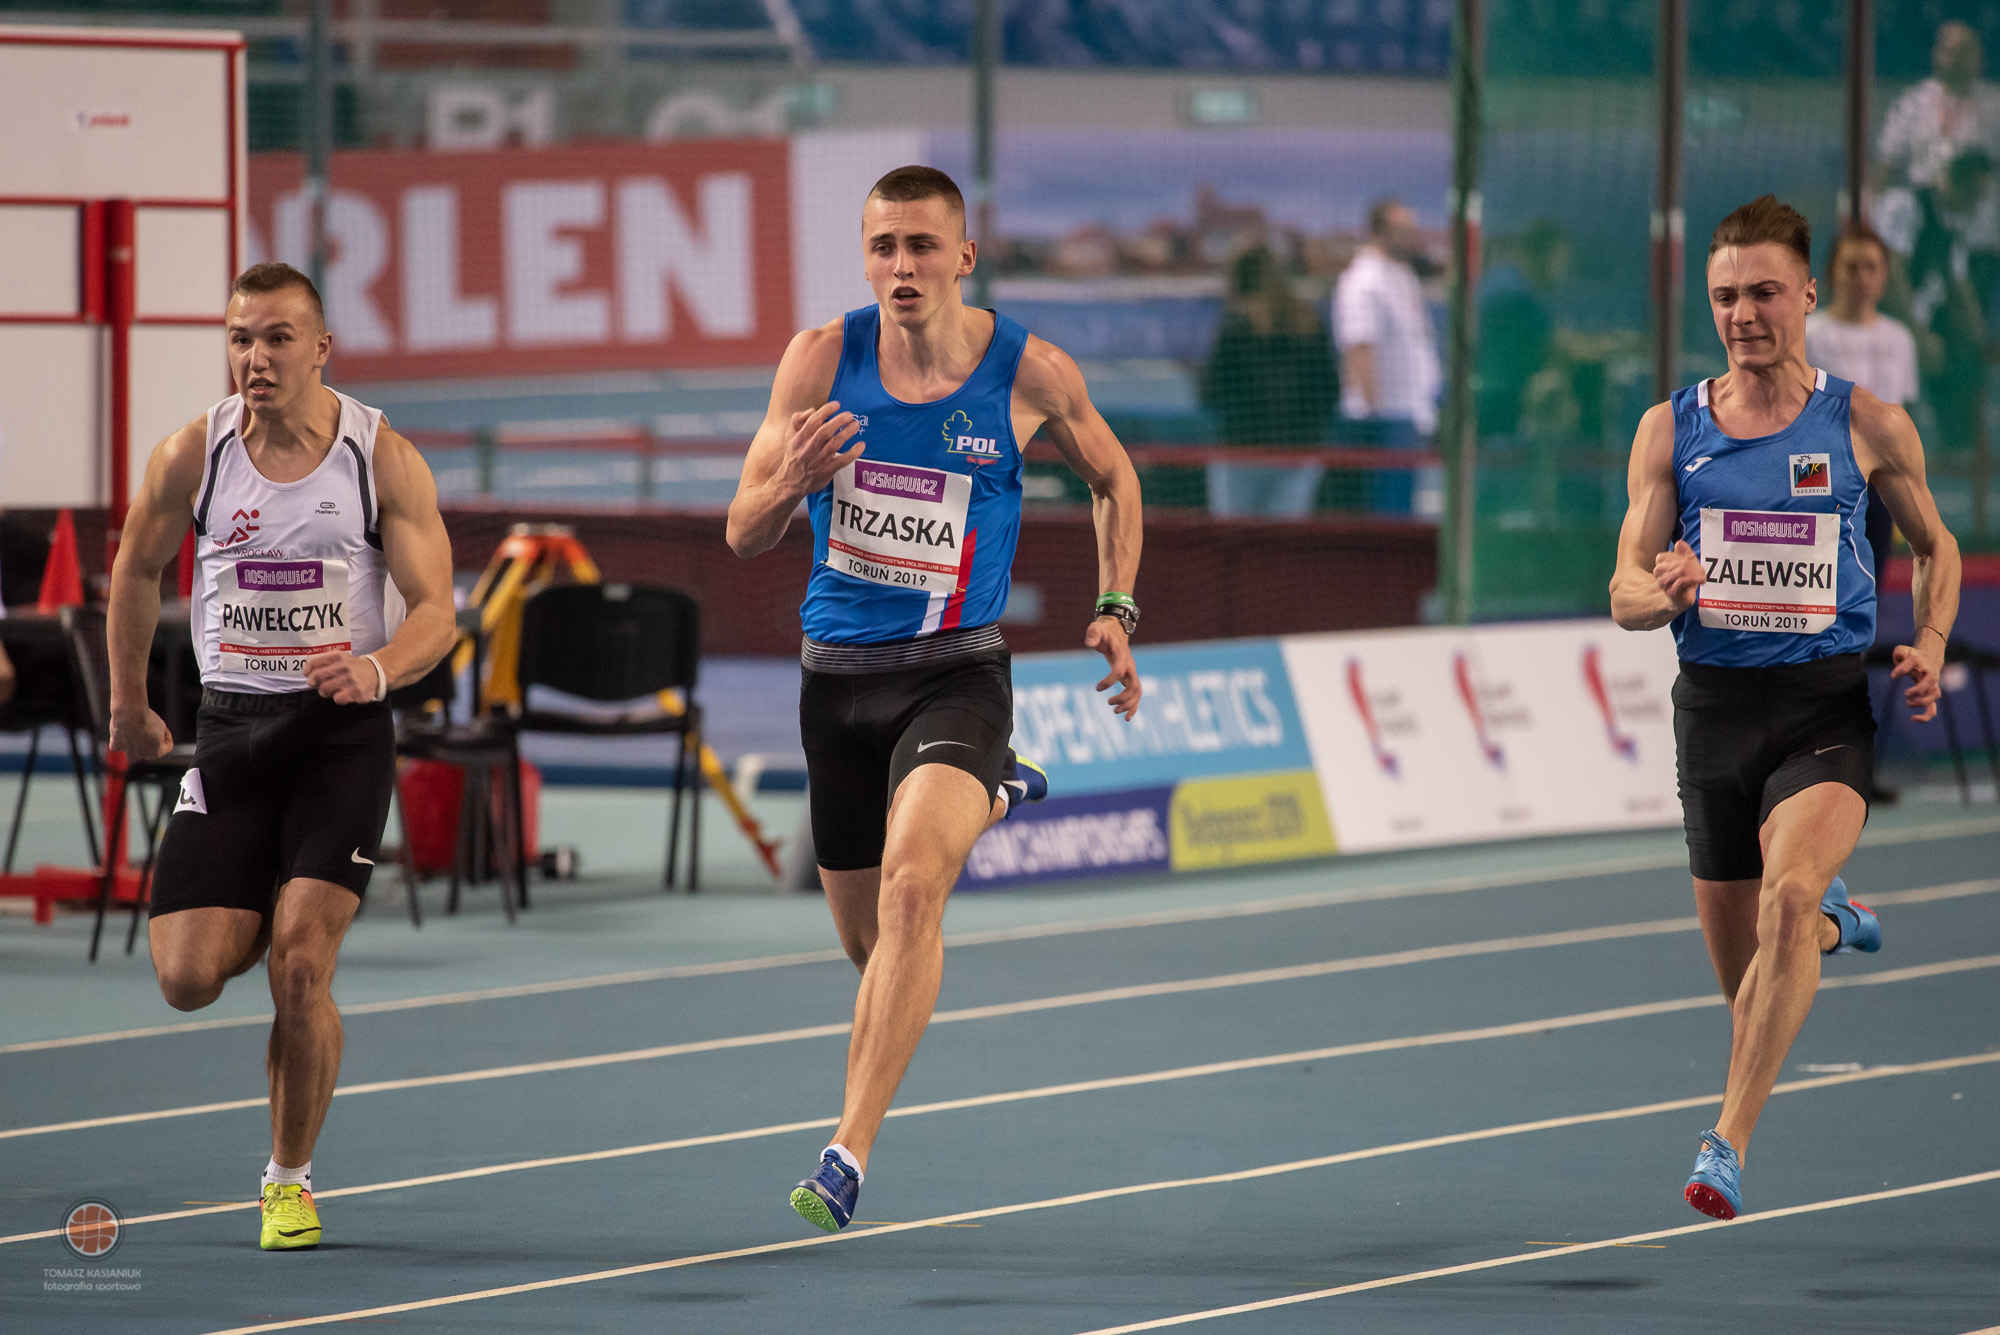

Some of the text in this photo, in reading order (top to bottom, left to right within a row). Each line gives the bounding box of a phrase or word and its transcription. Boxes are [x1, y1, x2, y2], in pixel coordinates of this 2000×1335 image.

[247, 172, 755, 355] RLEN
[956, 435, 1000, 454] POL
[837, 499, 955, 549] TRZASKA
[848, 558, 927, 587] TORUŃ 2019
[1705, 556, 1833, 589] ZALEWSKI
[222, 602, 344, 632] PAWEŁCZYK
[1725, 612, 1808, 629] TORUŃ 2019
[1742, 603, 1784, 611] MISTRZOSTWA
[244, 656, 307, 671] TORUŃ 20
